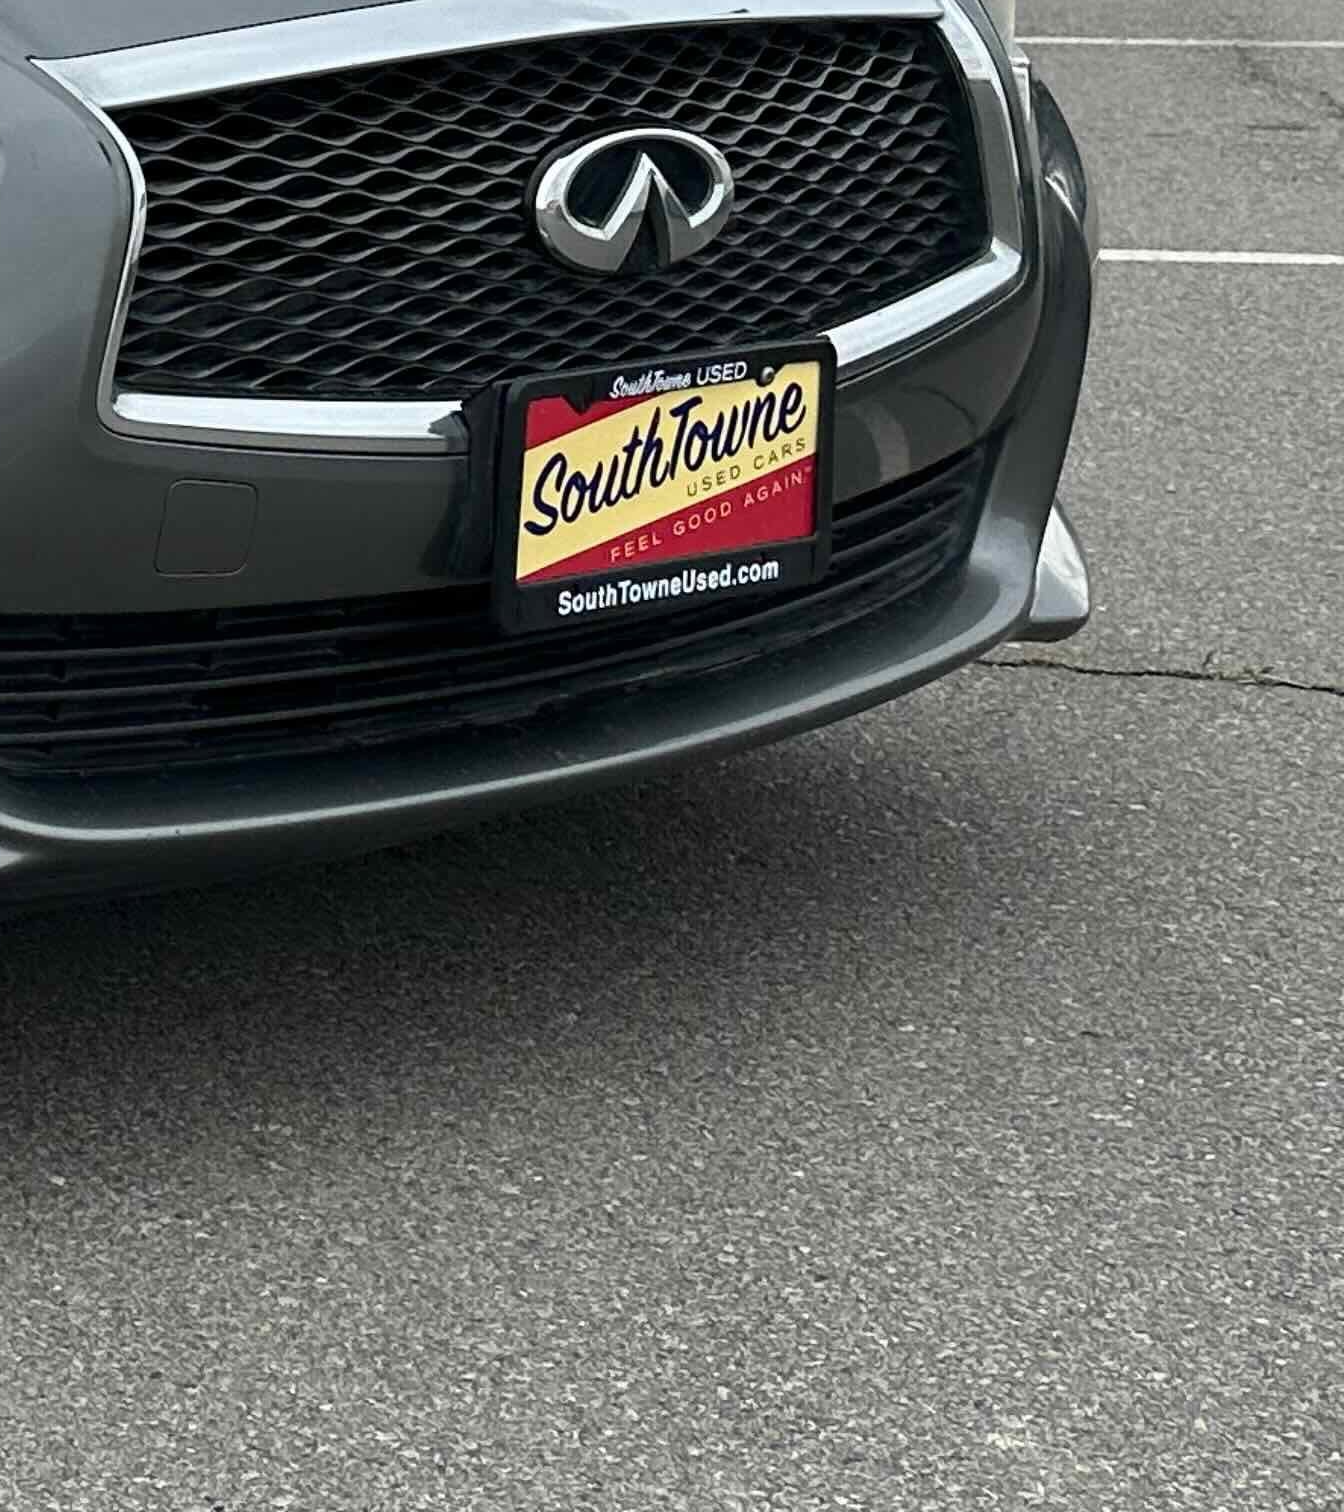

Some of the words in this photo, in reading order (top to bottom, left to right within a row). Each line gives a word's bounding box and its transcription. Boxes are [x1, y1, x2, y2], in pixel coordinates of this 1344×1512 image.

[696, 361, 748, 384] USED
[524, 382, 806, 535] SouthTowne
[687, 464, 742, 497] USED
[753, 437, 807, 470] CARS
[611, 533, 662, 564] FEEL
[673, 501, 732, 536] GOOD
[558, 560, 779, 615] SouthTowneUsed.com
